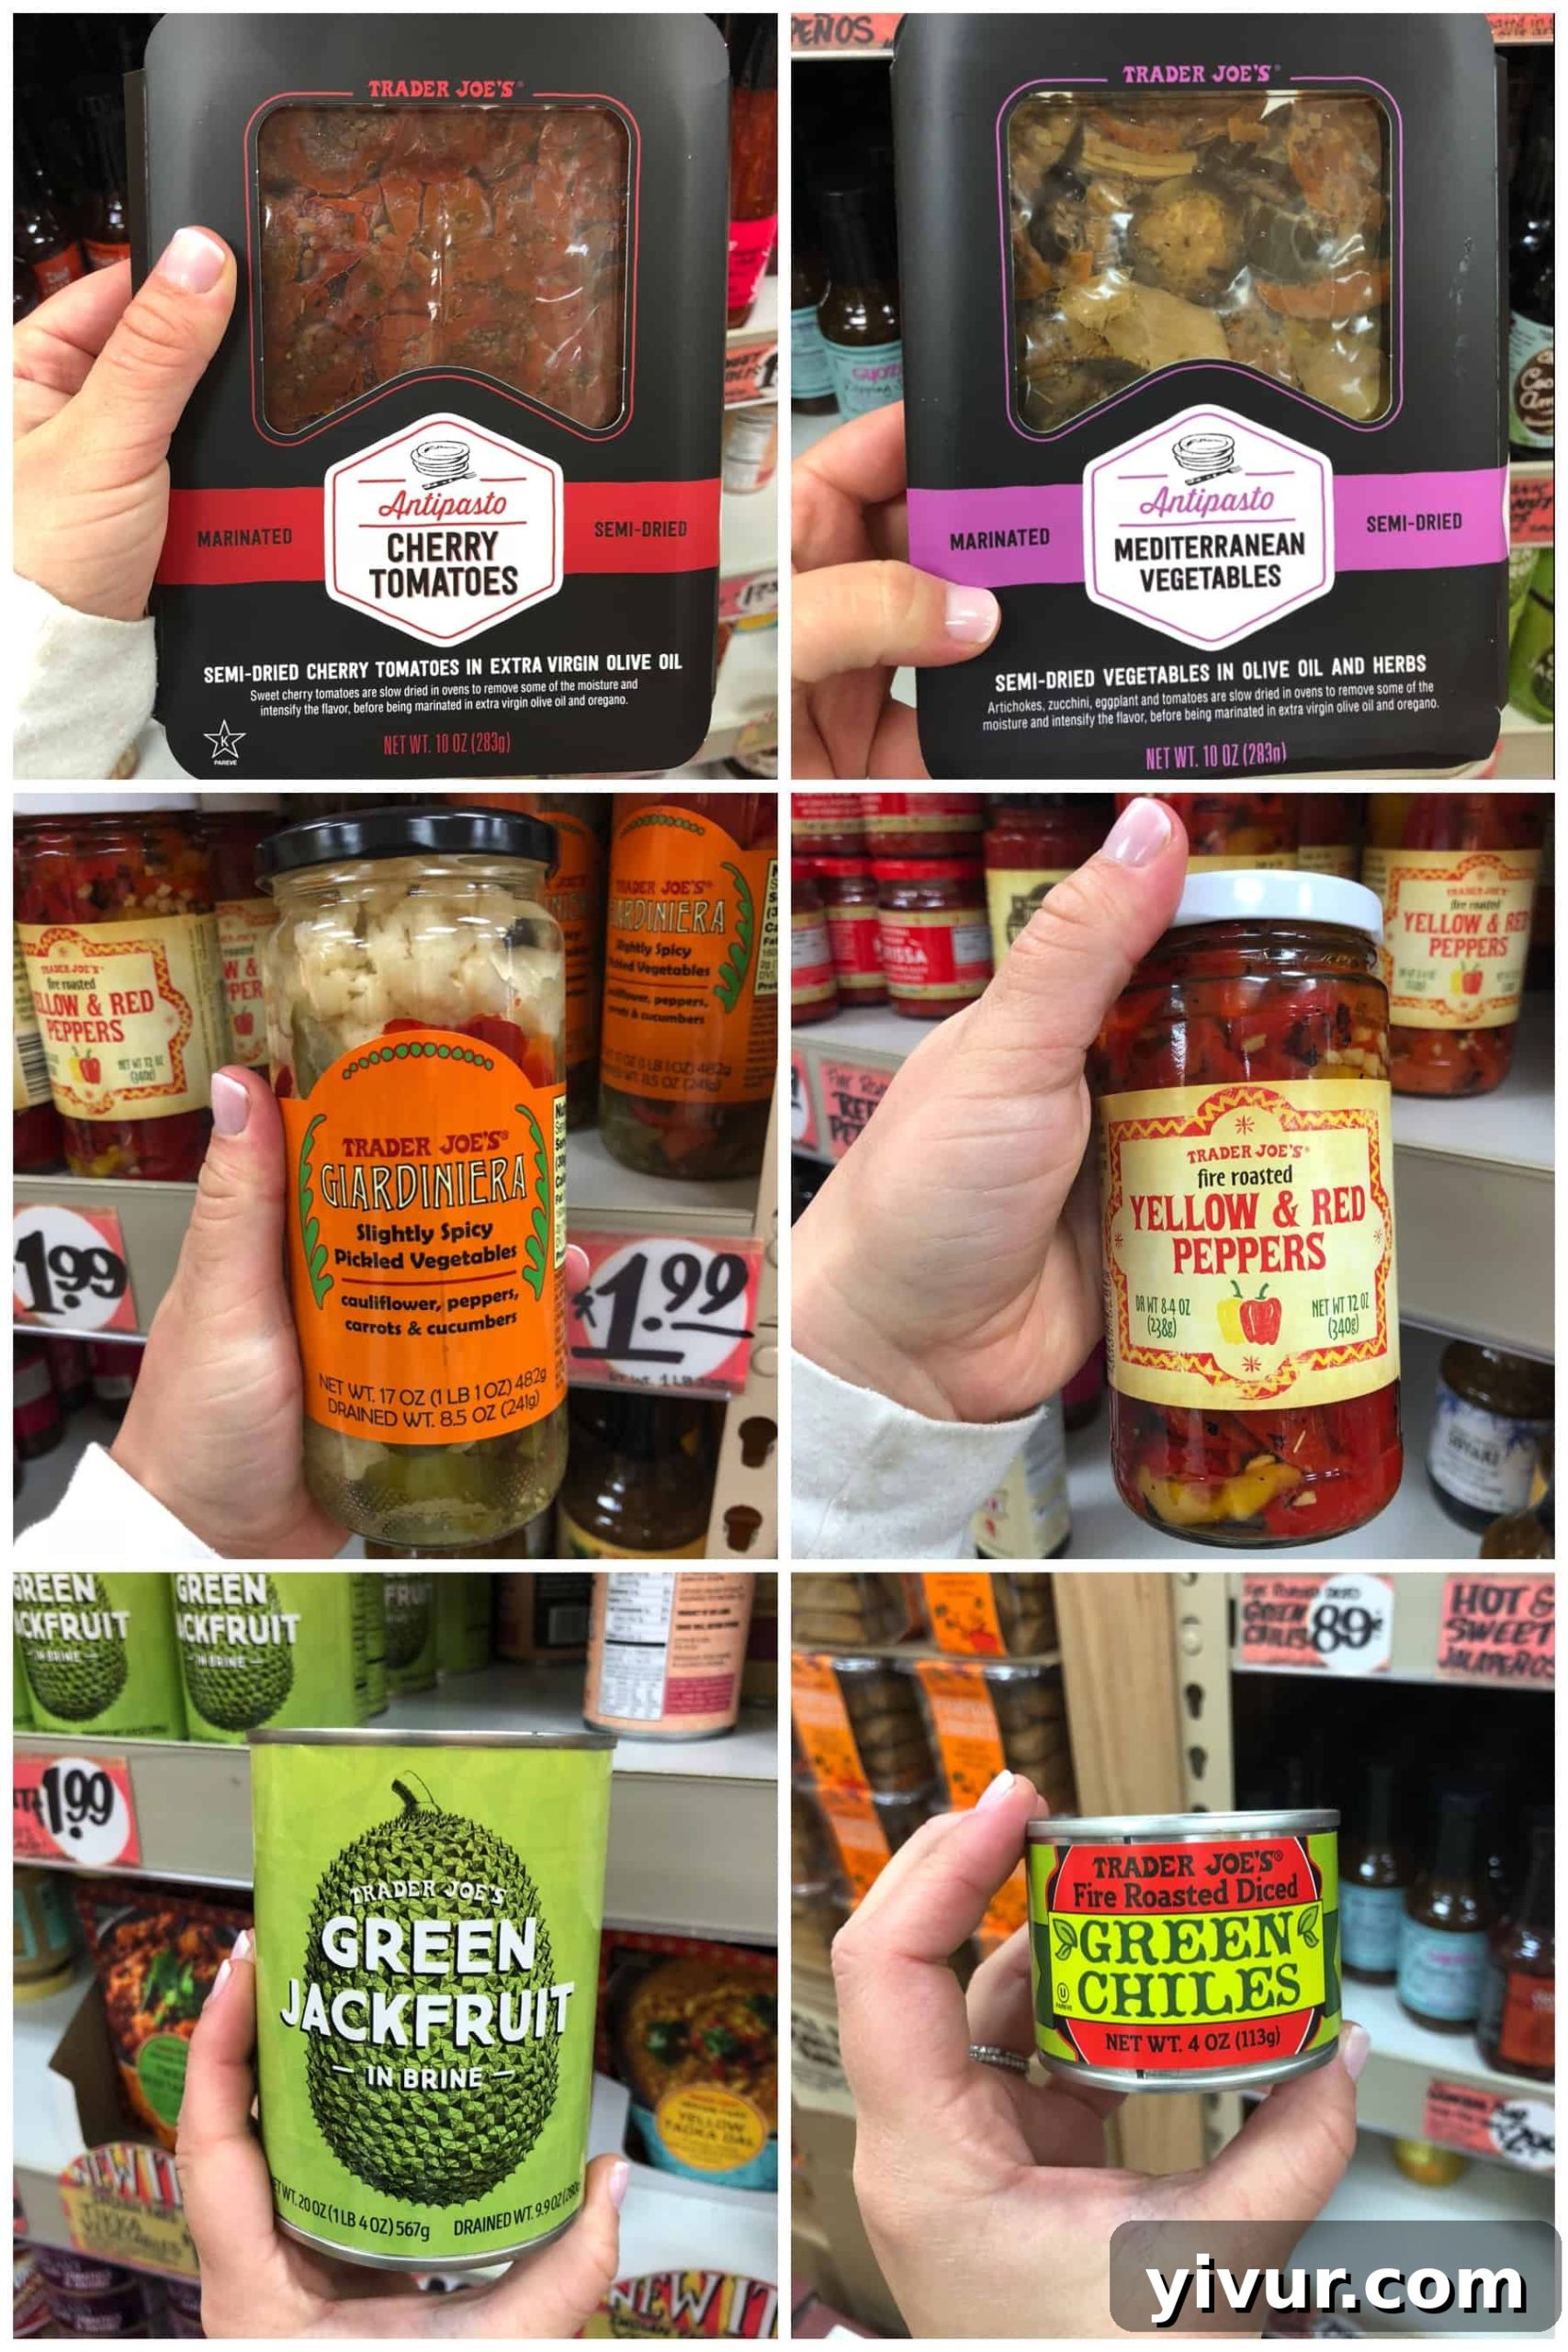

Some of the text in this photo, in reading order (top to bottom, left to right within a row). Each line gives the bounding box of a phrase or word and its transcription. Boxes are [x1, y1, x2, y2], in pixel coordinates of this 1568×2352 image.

[1123, 65, 1205, 84] TRADER
[368, 80, 450, 98] TRADER
[378, 490, 506, 521] Antipasto
[1139, 486, 1275, 518] Antipasto
[594, 521, 687, 537] SEMI-DRIED
[1367, 513, 1462, 533] SEMI-DRIED
[197, 528, 292, 548] MARINATED
[388, 531, 499, 562] CHERRY
[950, 527, 1050, 551] MARINATED
[1114, 532, 1305, 562] MEDITERRANEAN
[369, 566, 518, 599] TOMATOES
[1140, 563, 1281, 593] VEGETABLES
[204, 653, 682, 684] SEMI-DRIED CHERRY TOMATOES IN EXTRA VIRGIN OLIVE OIL
[995, 655, 1427, 692] SEMI-DRIED VEGETABLES IN OLIVE OIL AND HERBS
[251, 678, 637, 702] Sweet cherry tomatoes are slow dried in ovens to remove some of the moisture and
[383, 731, 511, 755] NET WT. 10 OZ (283g)
[1146, 747, 1170, 770] NET
[1174, 746, 1198, 768] WT.
[1203, 745, 1218, 767] 10
[1222, 743, 1238, 767] OZ
[1404, 912, 1482, 934] YELLOW
[1428, 936, 1509, 958] PEPPERS
[109, 989, 154, 1015] RED
[46, 1020, 125, 1043] PEPPERS
[342, 1137, 432, 1158] TRADER
[1187, 1145, 1252, 1164] TRADER
[321, 1153, 527, 1212] GIARDINIERA
[1198, 1164, 1293, 1189] fire roasted
[1130, 1184, 1367, 1232] YELLOW & RED
[356, 1221, 493, 1245] Slightly Spicy
[334, 1244, 517, 1271] Pickled Vegetables
[1172, 1232, 1326, 1275] PEPPERS
[341, 1288, 519, 1312] cauliflower, peppers,
[1147, 1295, 1158, 1313] WT
[1179, 1298, 1191, 1316] OZ
[1312, 1292, 1370, 1317] NET WT 12 OZ
[344, 1312, 517, 1336] carrots & cucumbers
[1147, 1315, 1177, 1339] (238g)
[1328, 1314, 1359, 1340] (340g)
[319, 1373, 344, 1395] NET
[348, 1385, 376, 1404] WT.
[380, 1388, 395, 1405] 17
[400, 1389, 425, 1406] OZ
[447, 1387, 470, 1404] LB
[475, 1385, 480, 1400] 1
[484, 1379, 513, 1399] OZ)
[515, 1367, 547, 1390] 482g
[328, 1392, 540, 1429] DRAINED WT. 8.5 OZ (241g)
[175, 1573, 267, 1605] GREEN
[1450, 1582, 1529, 1616] HOT
[1093, 1855, 1195, 1880] TRADER
[349, 1880, 507, 1905] TRADER JOE'S
[1073, 1873, 1298, 1908] Fire Roasted Diced
[321, 1916, 537, 1975] GREEN
[1080, 1910, 1293, 1966] GREEN
[1078, 1962, 1301, 2018] CHILES
[280, 1978, 575, 2049] JACKFRUIT
[1106, 2026, 1280, 2053] NET WT. 4 OZ (113g)
[367, 2065, 482, 2089] IN BRINE
[282, 2186, 298, 2206] WT.
[299, 2194, 310, 2212] 20
[313, 2200, 327, 2220] OZ
[341, 2211, 356, 2228] LB
[359, 2215, 367, 2231] 4
[370, 2217, 393, 2236] OZ)
[397, 2222, 430, 2242] 567g
[454, 2193, 563, 2236] DRAINED WT. 9.9 OZ
